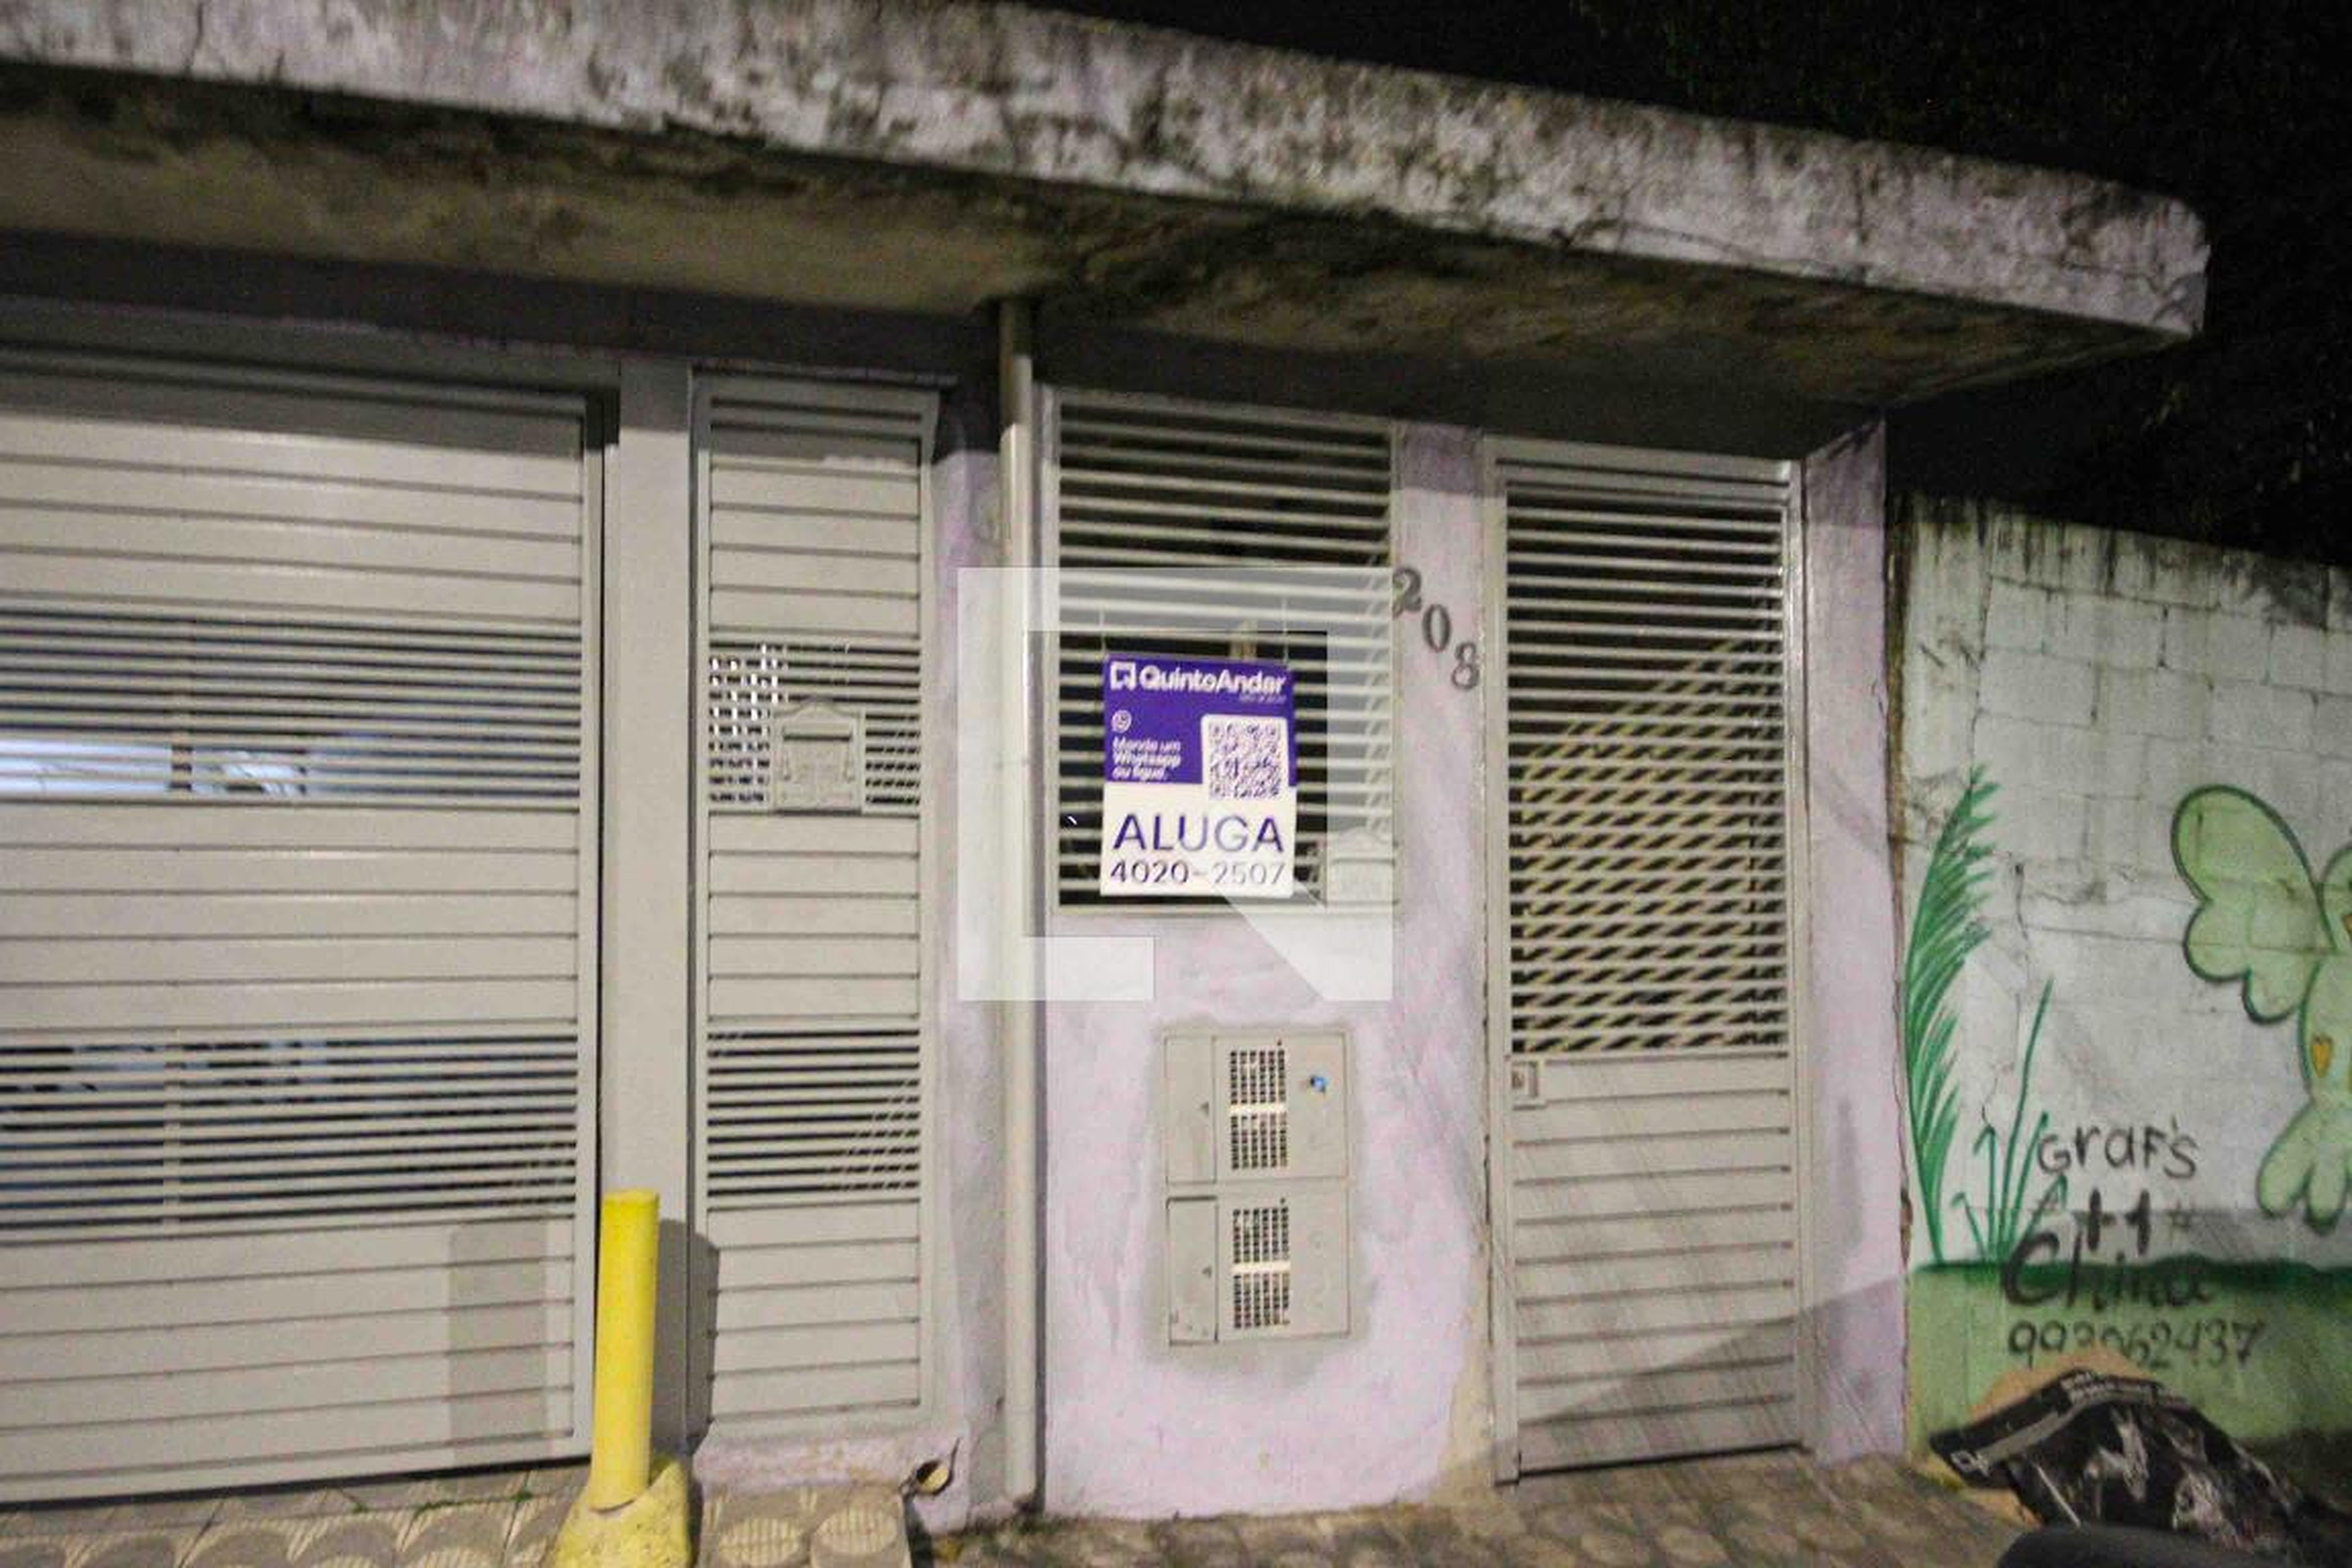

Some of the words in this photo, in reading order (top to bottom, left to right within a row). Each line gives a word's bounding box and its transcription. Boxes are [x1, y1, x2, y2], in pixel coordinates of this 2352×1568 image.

[1392, 566, 1480, 691] 208
[1139, 665, 1286, 695] QuintoAndar
[1113, 813, 1284, 853] ALUGA
[1110, 859, 1286, 885] 4020-2507
